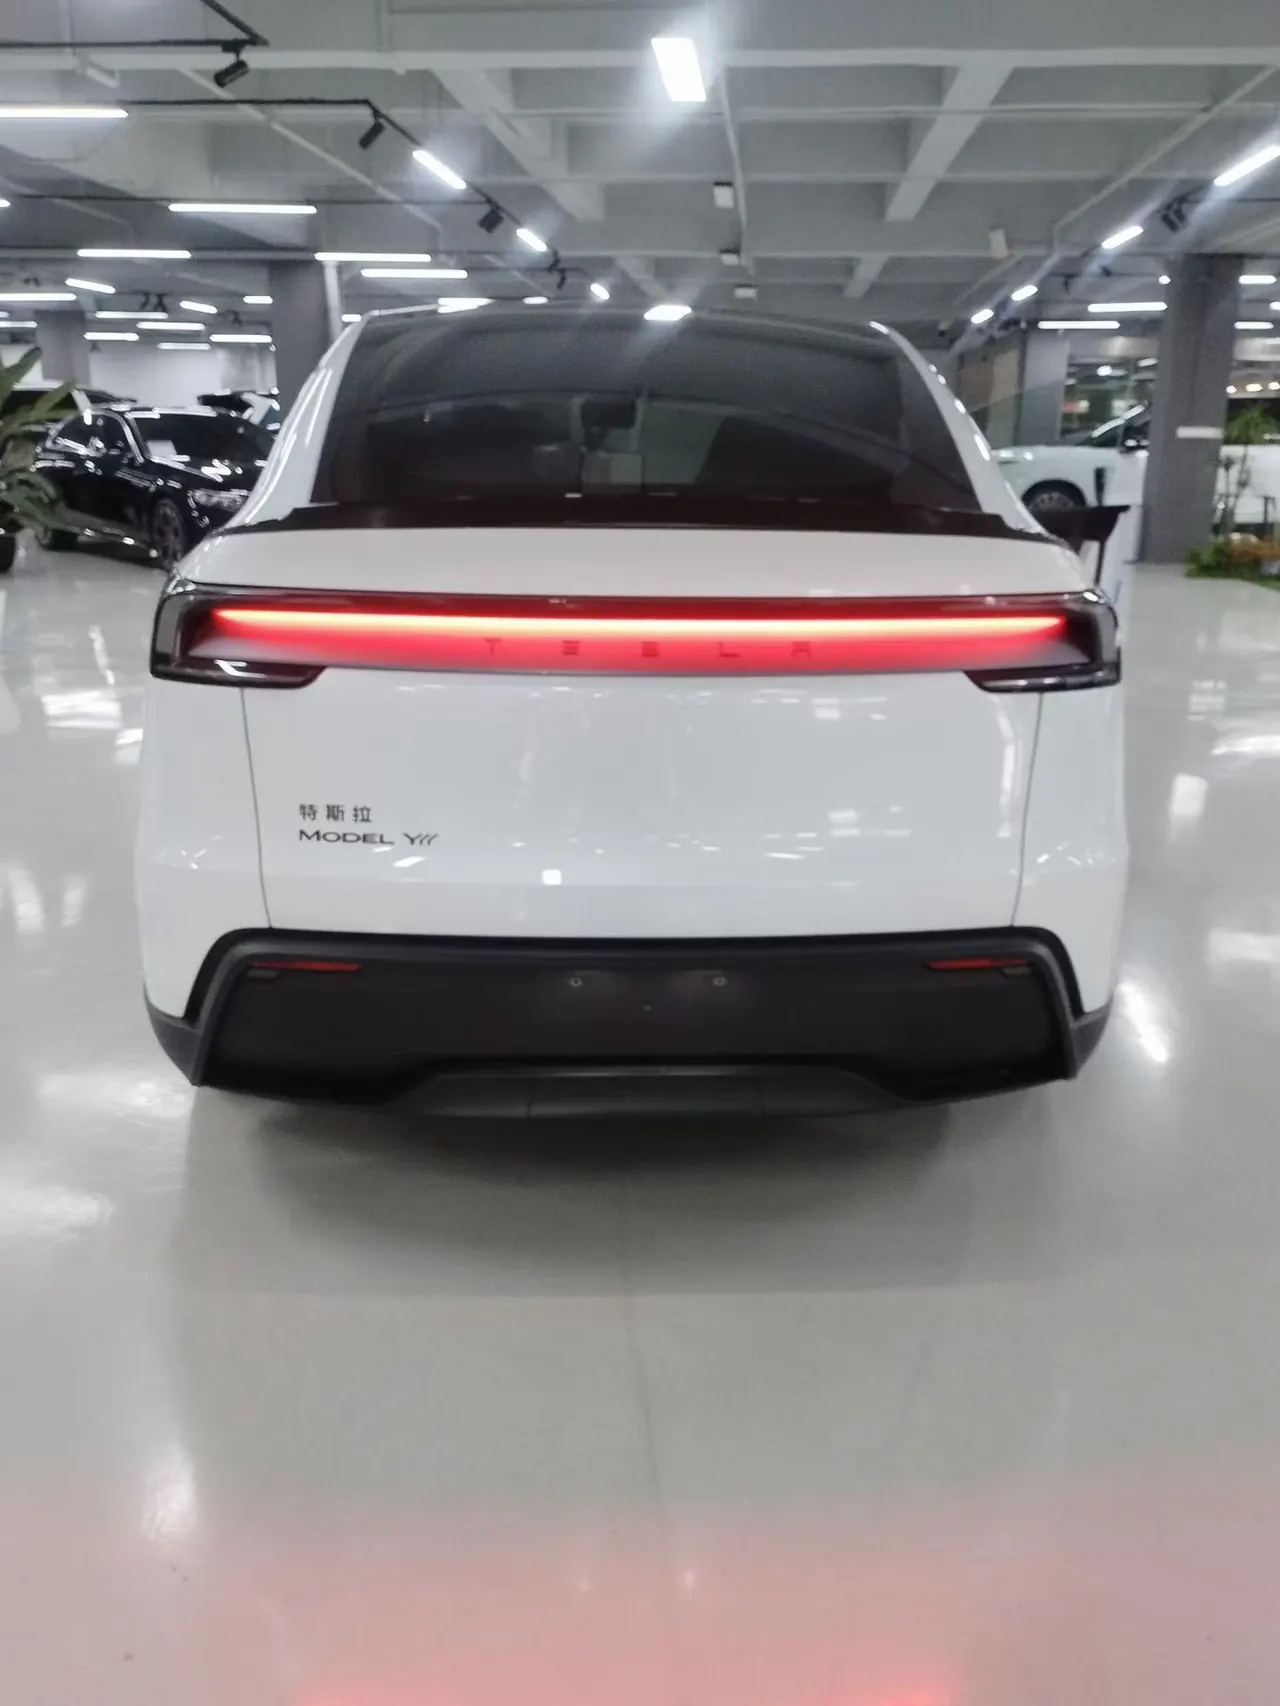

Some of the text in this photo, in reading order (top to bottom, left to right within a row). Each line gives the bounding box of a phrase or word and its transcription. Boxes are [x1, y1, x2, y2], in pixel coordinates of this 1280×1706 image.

[485, 637, 813, 658] TESLA
[299, 804, 373, 823] 特斯拉
[299, 829, 395, 845] MODEL
